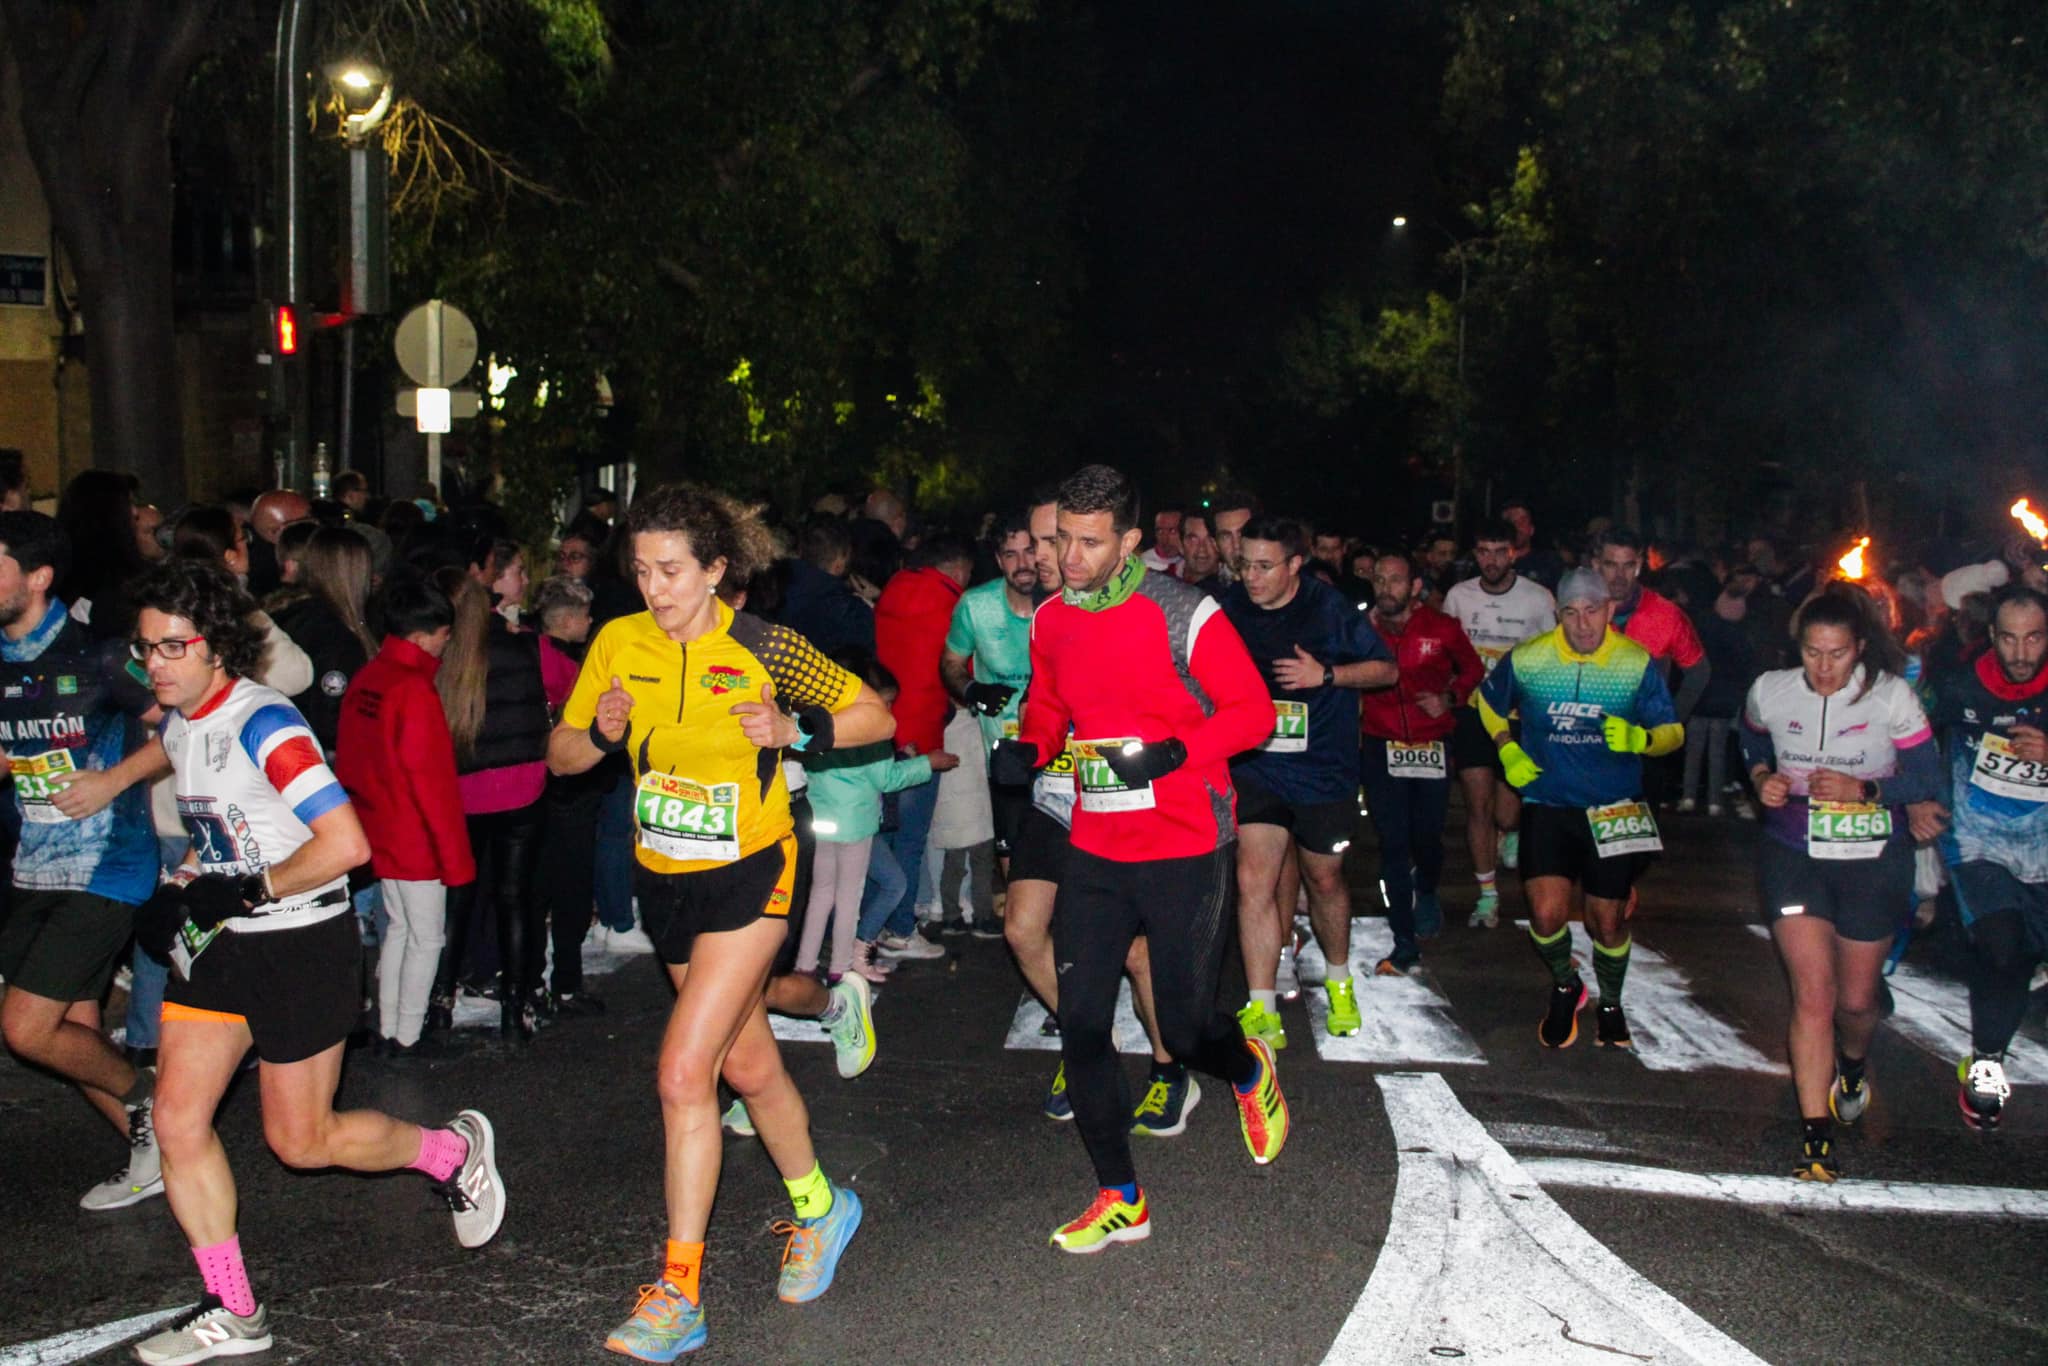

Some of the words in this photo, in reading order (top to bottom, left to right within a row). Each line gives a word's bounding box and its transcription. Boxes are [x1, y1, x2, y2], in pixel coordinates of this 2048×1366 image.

[1547, 701, 1602, 718] LINCE
[17, 712, 85, 739] ANTÓN
[1393, 750, 1440, 764] 9060
[1984, 752, 2048, 781] 5735
[661, 777, 679, 794] 42
[644, 795, 726, 834] 1843
[1817, 813, 1886, 836] 1456
[1598, 815, 1653, 840] 2464
